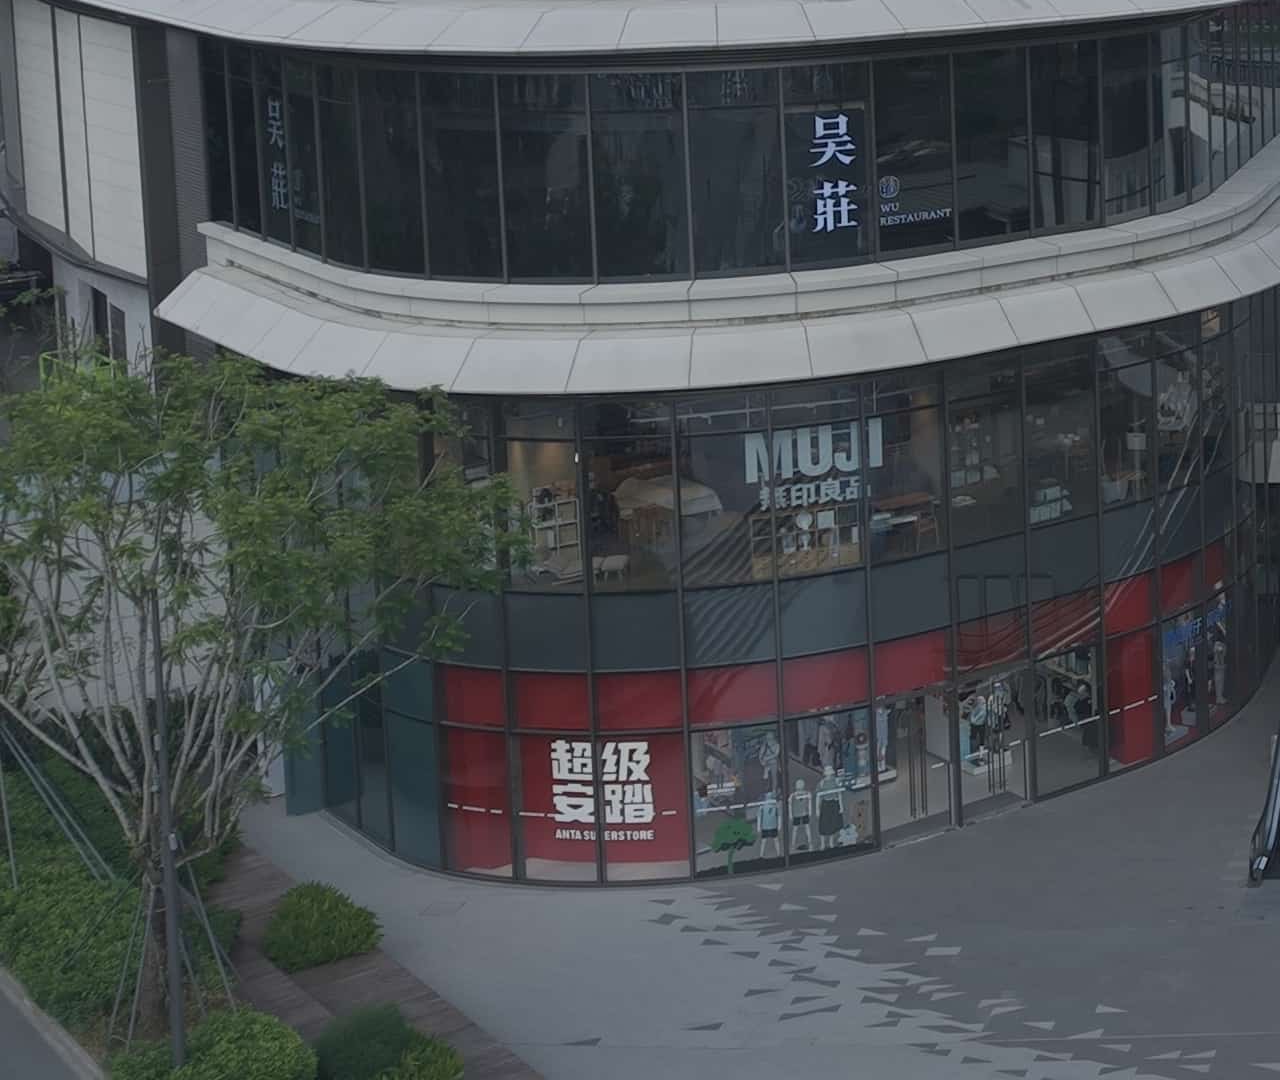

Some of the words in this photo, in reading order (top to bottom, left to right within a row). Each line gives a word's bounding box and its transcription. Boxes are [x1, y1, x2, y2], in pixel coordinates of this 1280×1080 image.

[879, 208, 952, 227] RESTAURANT
[880, 202, 900, 213] WU
[745, 417, 884, 484] MUJI
[550, 740, 651, 782] 超级
[552, 783, 654, 824] 安踏
[555, 828, 582, 840] ANTA
[583, 829, 655, 841] SUERSTORE
